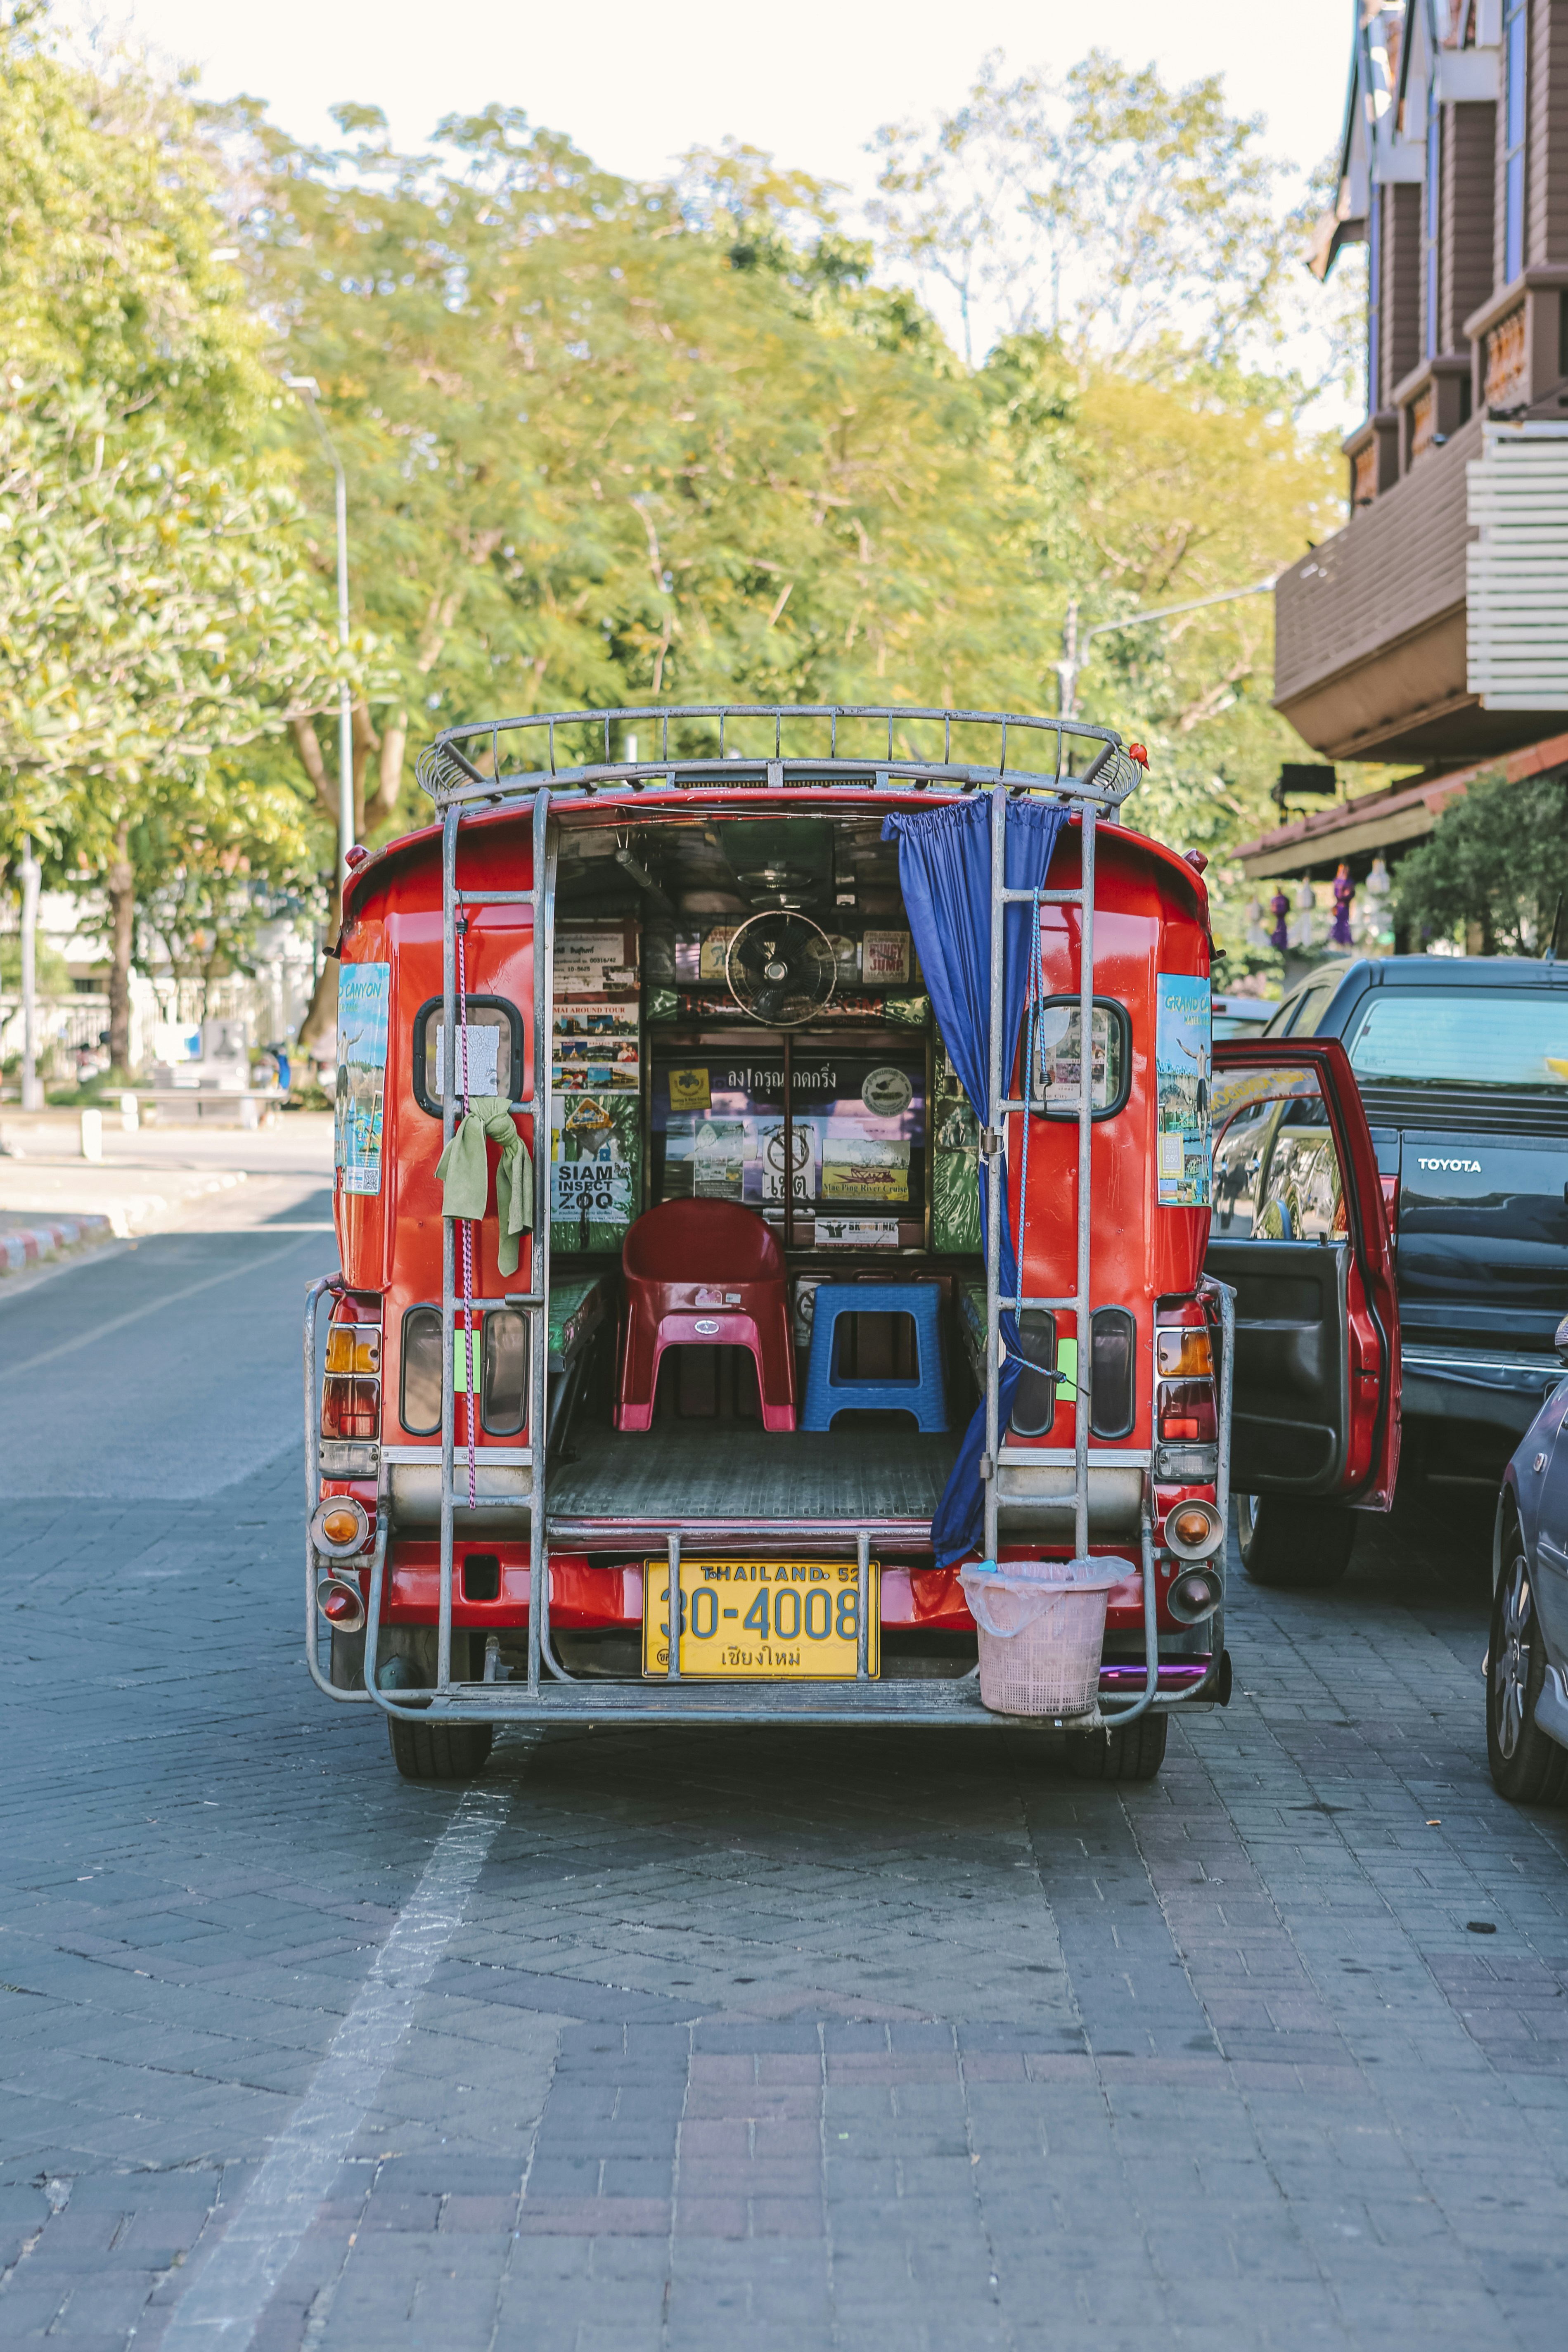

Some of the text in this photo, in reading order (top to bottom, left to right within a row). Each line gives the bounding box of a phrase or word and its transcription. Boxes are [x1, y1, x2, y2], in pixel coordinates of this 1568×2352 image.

[869, 959, 903, 971] JUMP
[346, 983, 382, 1001] CANYON
[1165, 995, 1199, 1013] GRAND
[559, 1166, 613, 1180] SIAM
[1417, 1158, 1482, 1173] TOYOTA
[559, 1181, 613, 1191] INSECT
[842, 1184, 858, 1192] Ping
[861, 1184, 881, 1192] River
[883, 1184, 907, 1193] Cruise
[559, 1192, 613, 1210] ZOO
[701, 1566, 823, 1581] THAILAND
[661, 1587, 858, 1640] 30-4008
[722, 1646, 800, 1665] เชียงใหม่
